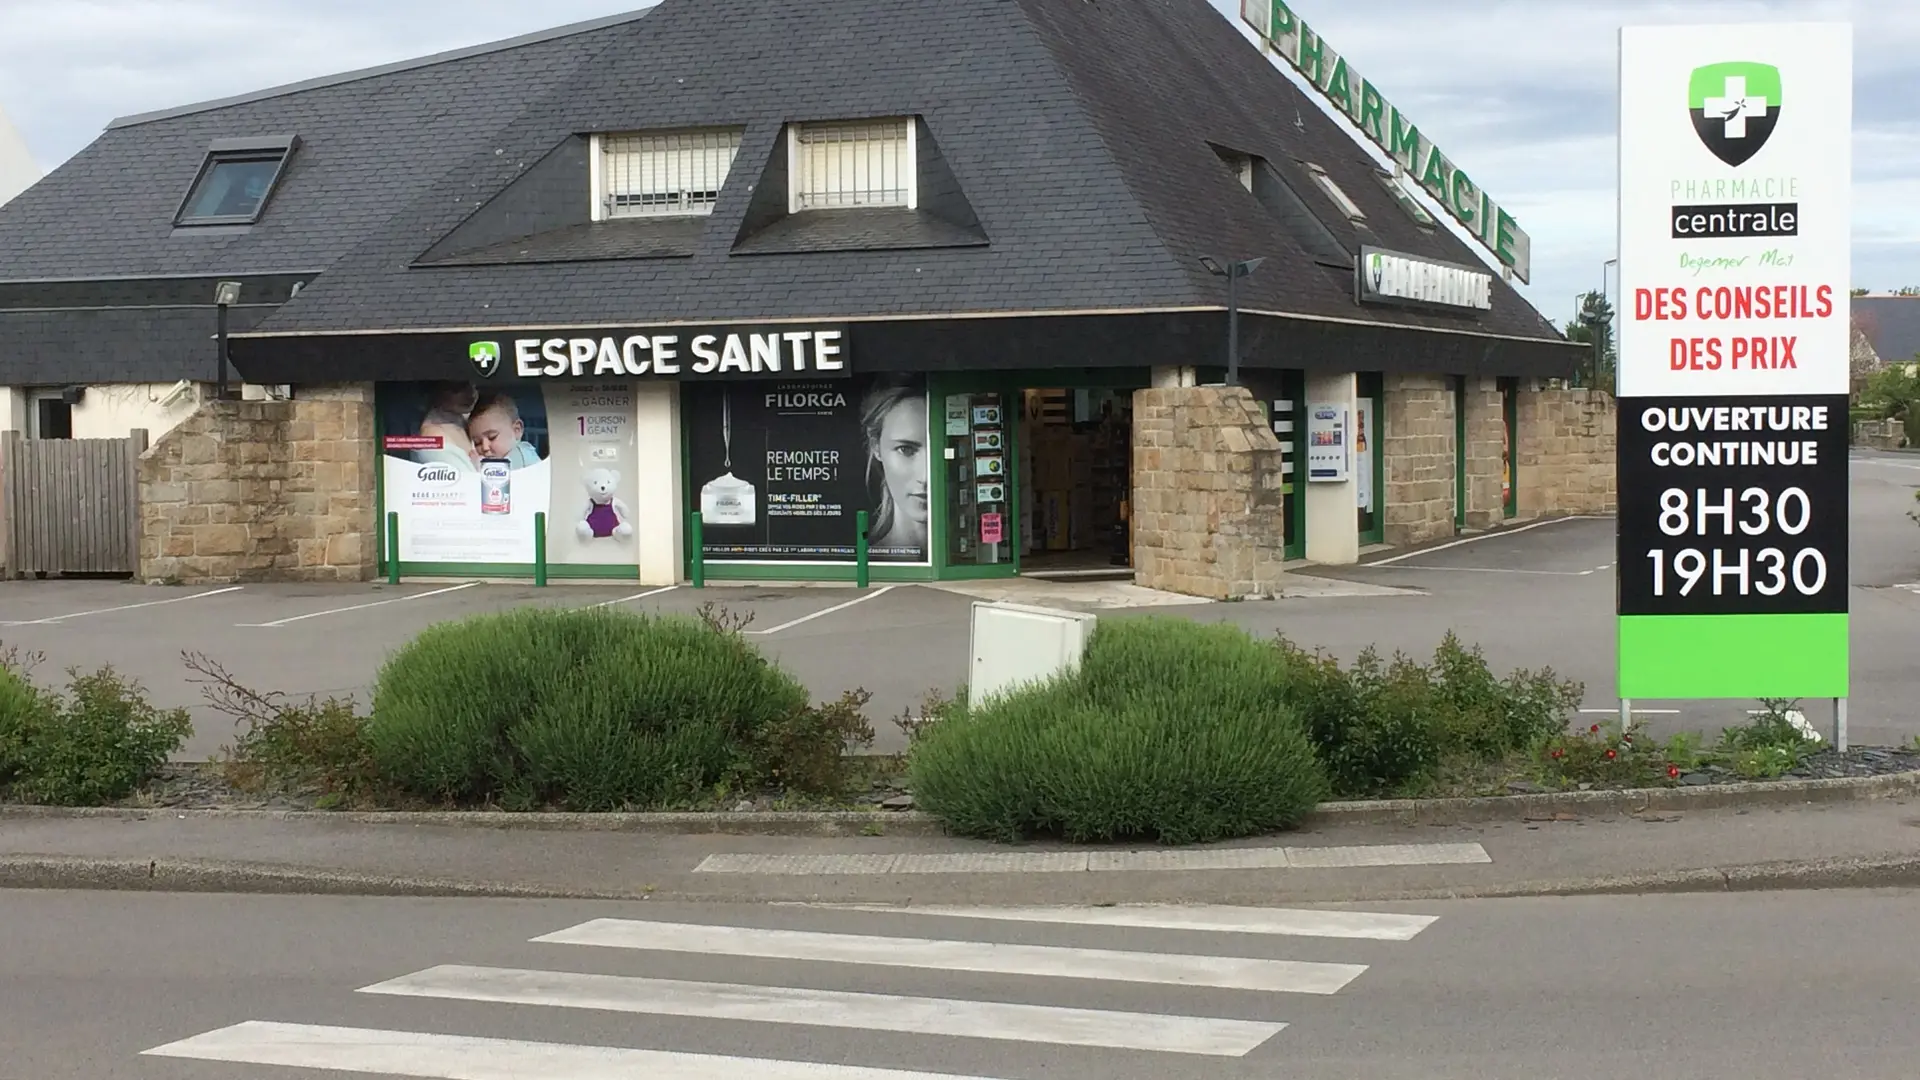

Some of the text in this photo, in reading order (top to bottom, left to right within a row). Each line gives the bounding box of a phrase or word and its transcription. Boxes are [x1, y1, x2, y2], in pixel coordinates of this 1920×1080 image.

[1268, 0, 1517, 266] PHARMACIE
[1671, 177, 1798, 199] PHARMACIE
[1675, 205, 1795, 233] centrale
[1635, 284, 1833, 321] DES CONSEILS
[514, 331, 844, 377] ESPACE SANTE
[1670, 336, 1798, 371] DES PRIX
[581, 396, 630, 407] GAGNER
[765, 393, 846, 408] FILORGA
[577, 415, 585, 436] 1
[1641, 406, 1829, 432] OUVERTURE
[767, 450, 840, 465] REMONTER
[1651, 441, 1818, 467] CONTINUE
[417, 466, 456, 482] Gallia
[767, 467, 838, 481] LE TEMPS !
[1658, 486, 1811, 536] 8H30
[1646, 547, 1827, 597] 19H30
